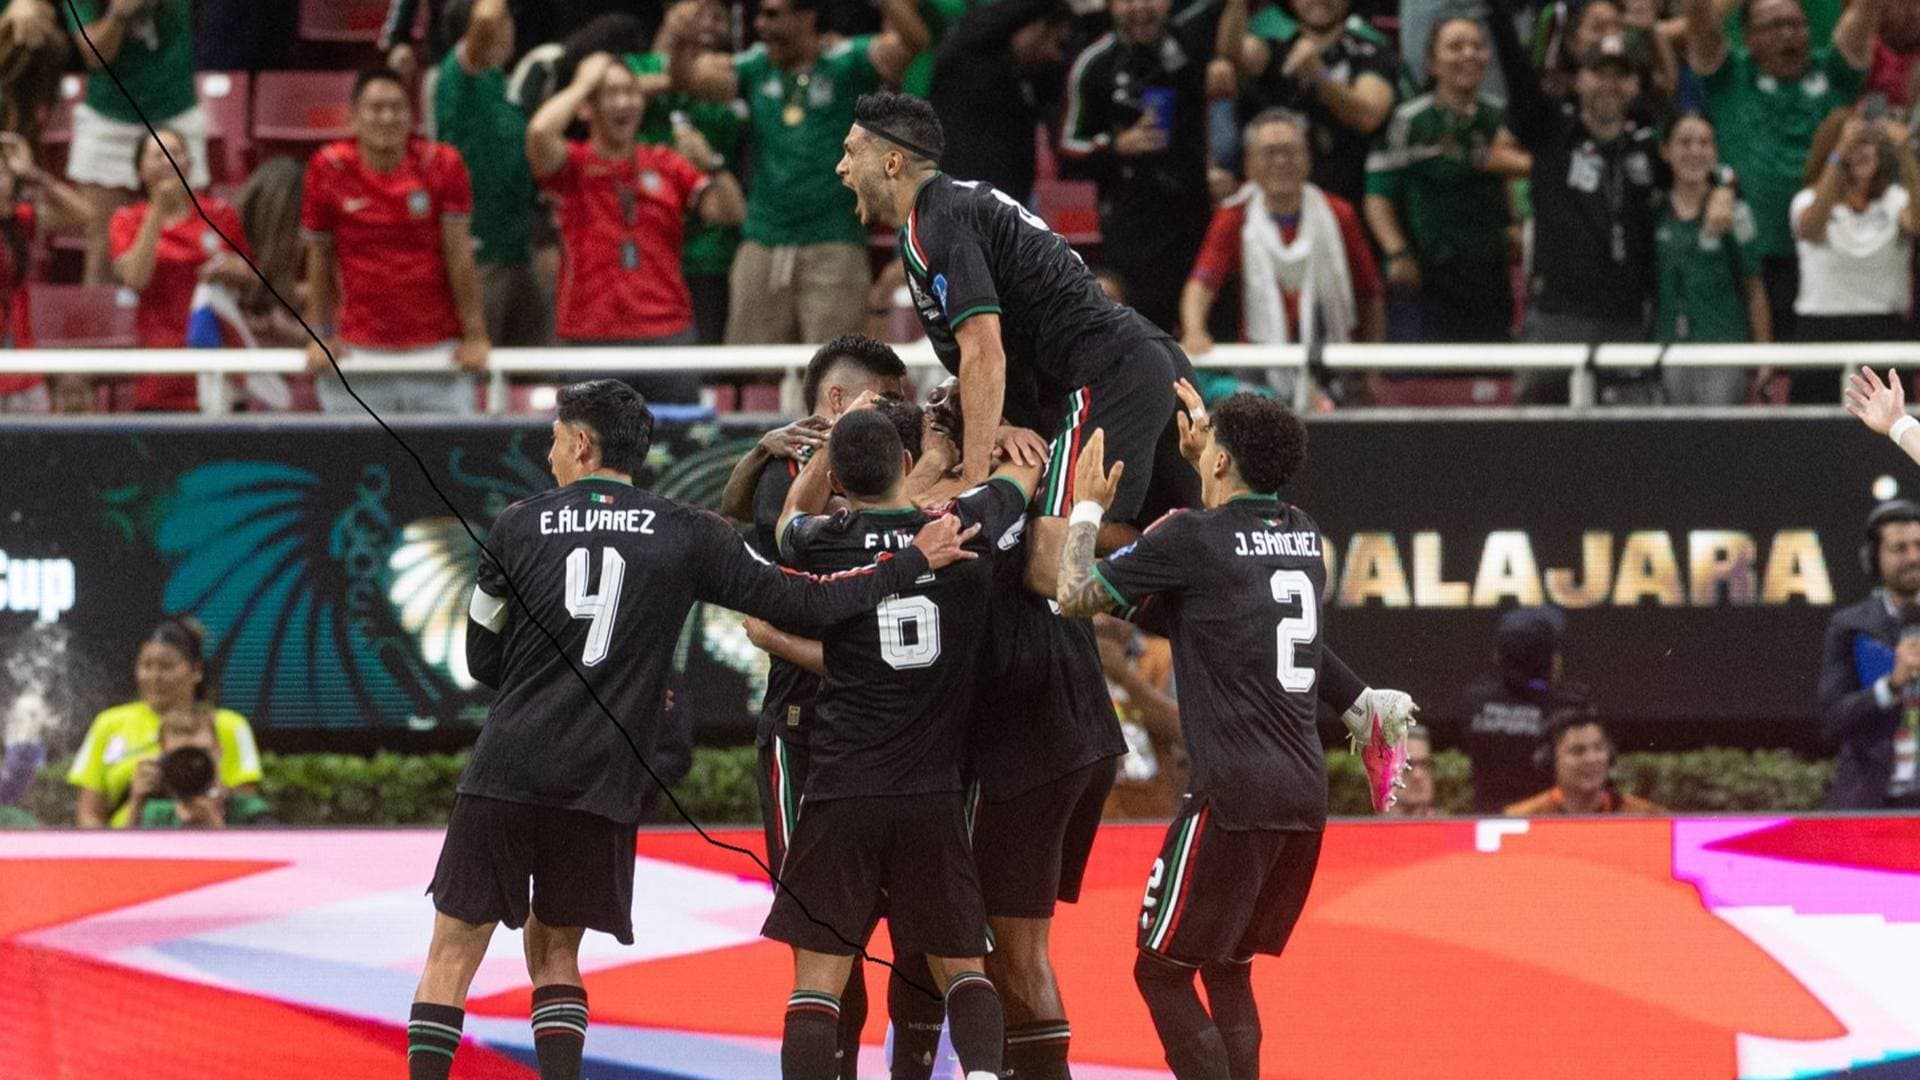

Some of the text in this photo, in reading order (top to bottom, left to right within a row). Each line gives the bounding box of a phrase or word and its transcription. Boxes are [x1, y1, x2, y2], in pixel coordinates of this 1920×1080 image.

[540, 506, 656, 535] E.ÁLVAREZ
[1235, 530, 1320, 557] J.SÁNCHEZ
[0, 548, 76, 623] up
[565, 546, 626, 667] 4
[1321, 530, 1835, 608] ALAJARA
[877, 571, 941, 671] 6
[1270, 569, 1317, 693] 2
